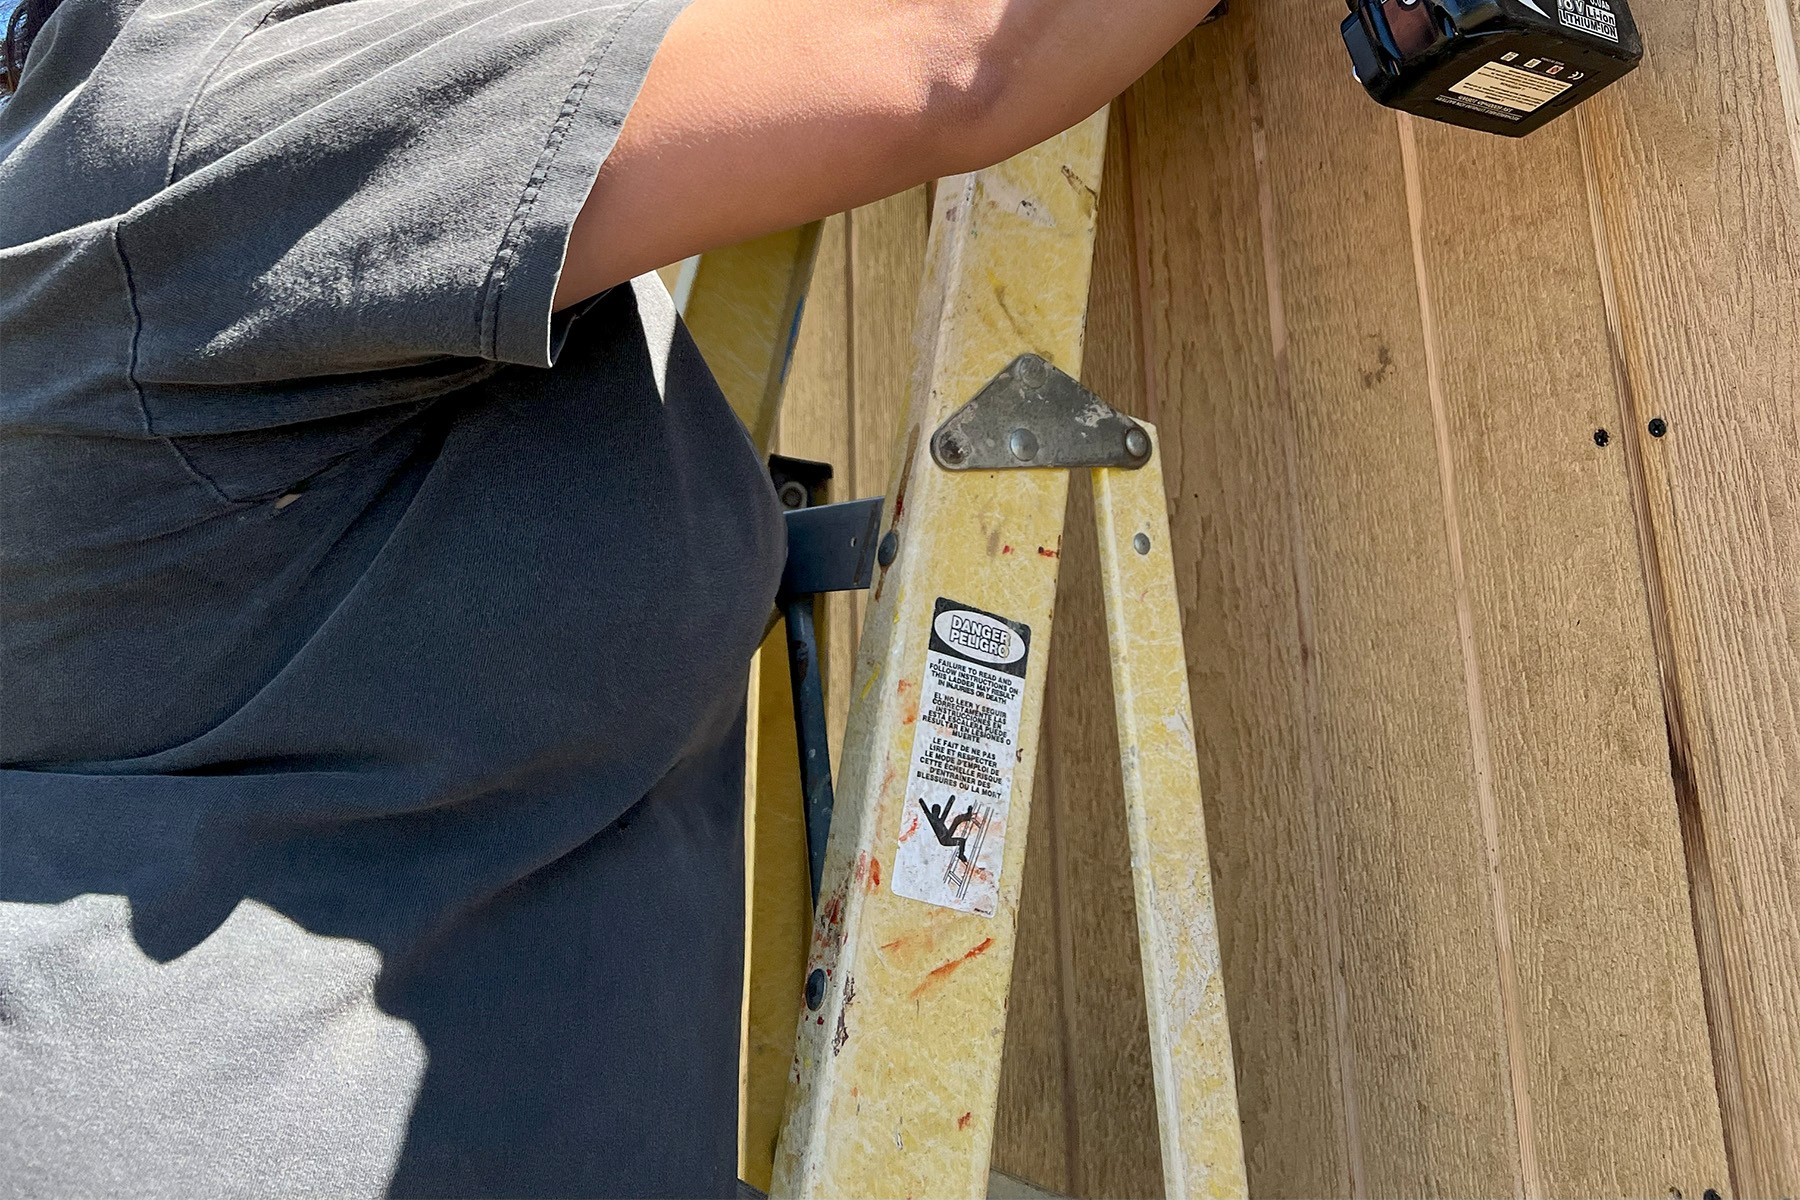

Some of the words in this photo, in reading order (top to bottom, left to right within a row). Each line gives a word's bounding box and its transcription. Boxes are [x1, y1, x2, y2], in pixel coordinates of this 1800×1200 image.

[1559, 9, 1617, 38] LITHIUM-ION
[950, 629, 1009, 658] PELIGRO
[952, 615, 1011, 646] DANGER
[929, 663, 957, 675] FOLLOW
[958, 671, 1007, 691] INSTRUCTIONS
[931, 670, 946, 679] THIS
[948, 676, 974, 688] LADDER
[977, 683, 991, 693] MAY
[991, 688, 1015, 700] RESULT
[938, 659, 965, 672] FAILURE
[968, 667, 977, 675] TO
[979, 671, 996, 681] READ
[999, 677, 1012, 686] AND
[938, 679, 945, 687] IN
[946, 681, 974, 695] INJURIES
[986, 694, 1006, 705] DEATH
[932, 698, 992, 720] CORRECTAMENTE
[994, 716, 1006, 724] LAS
[936, 706, 991, 726] INSTRUCCIONES
[956, 698, 973, 707] LEER
[982, 706, 1006, 718] SEGUIR
[922, 715, 958, 729] RESULTAR
[971, 730, 1004, 743] LESIONES
[928, 710, 946, 720] ESTA
[948, 715, 983, 731] ESCALERA
[985, 726, 1007, 738] PUEDE
[952, 730, 980, 743] MUERTE
[925, 750, 933, 758] LE
[935, 753, 955, 764] MODE
[957, 759, 988, 773] D'EMPLOI
[929, 744, 945, 753] LIRE
[957, 751, 997, 768] RESPECTER
[933, 737, 941, 745] LE
[943, 740, 959, 750] FAIT
[960, 745, 969, 753] DE
[982, 751, 996, 760] PAS
[920, 757, 942, 768] CETTE
[977, 772, 1002, 784] RISQUE
[917, 771, 957, 787] BLESSURES
[971, 786, 980, 794] LA
[981, 789, 1001, 799] MORT
[977, 780, 991, 789] DES
